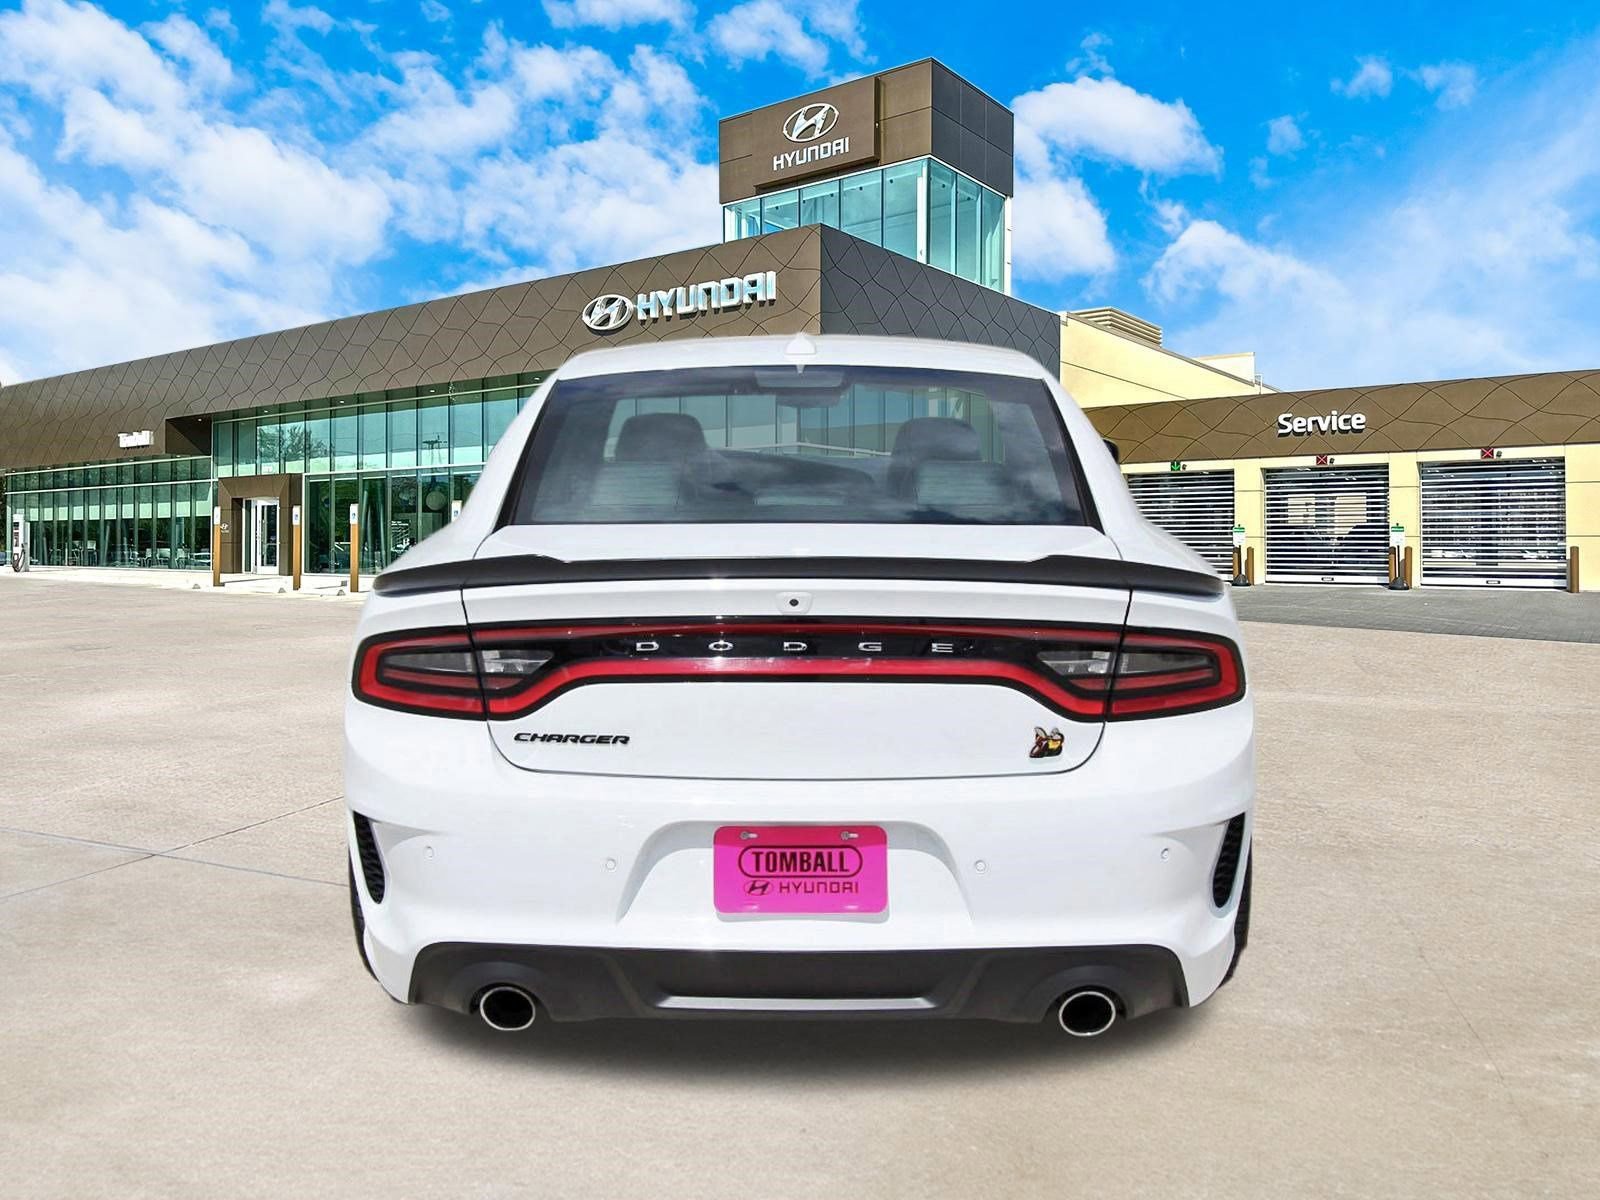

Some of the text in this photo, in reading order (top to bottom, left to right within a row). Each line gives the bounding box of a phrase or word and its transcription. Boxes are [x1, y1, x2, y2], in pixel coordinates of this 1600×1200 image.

[773, 137, 849, 171] HYUNDAI
[637, 271, 776, 321] HYUNDAI
[1278, 410, 1366, 434] Service
[636, 641, 953, 653] DODGE
[514, 732, 630, 745] CHARGER
[752, 851, 849, 872] TOMBALL
[779, 881, 859, 894] HYUNDAI
